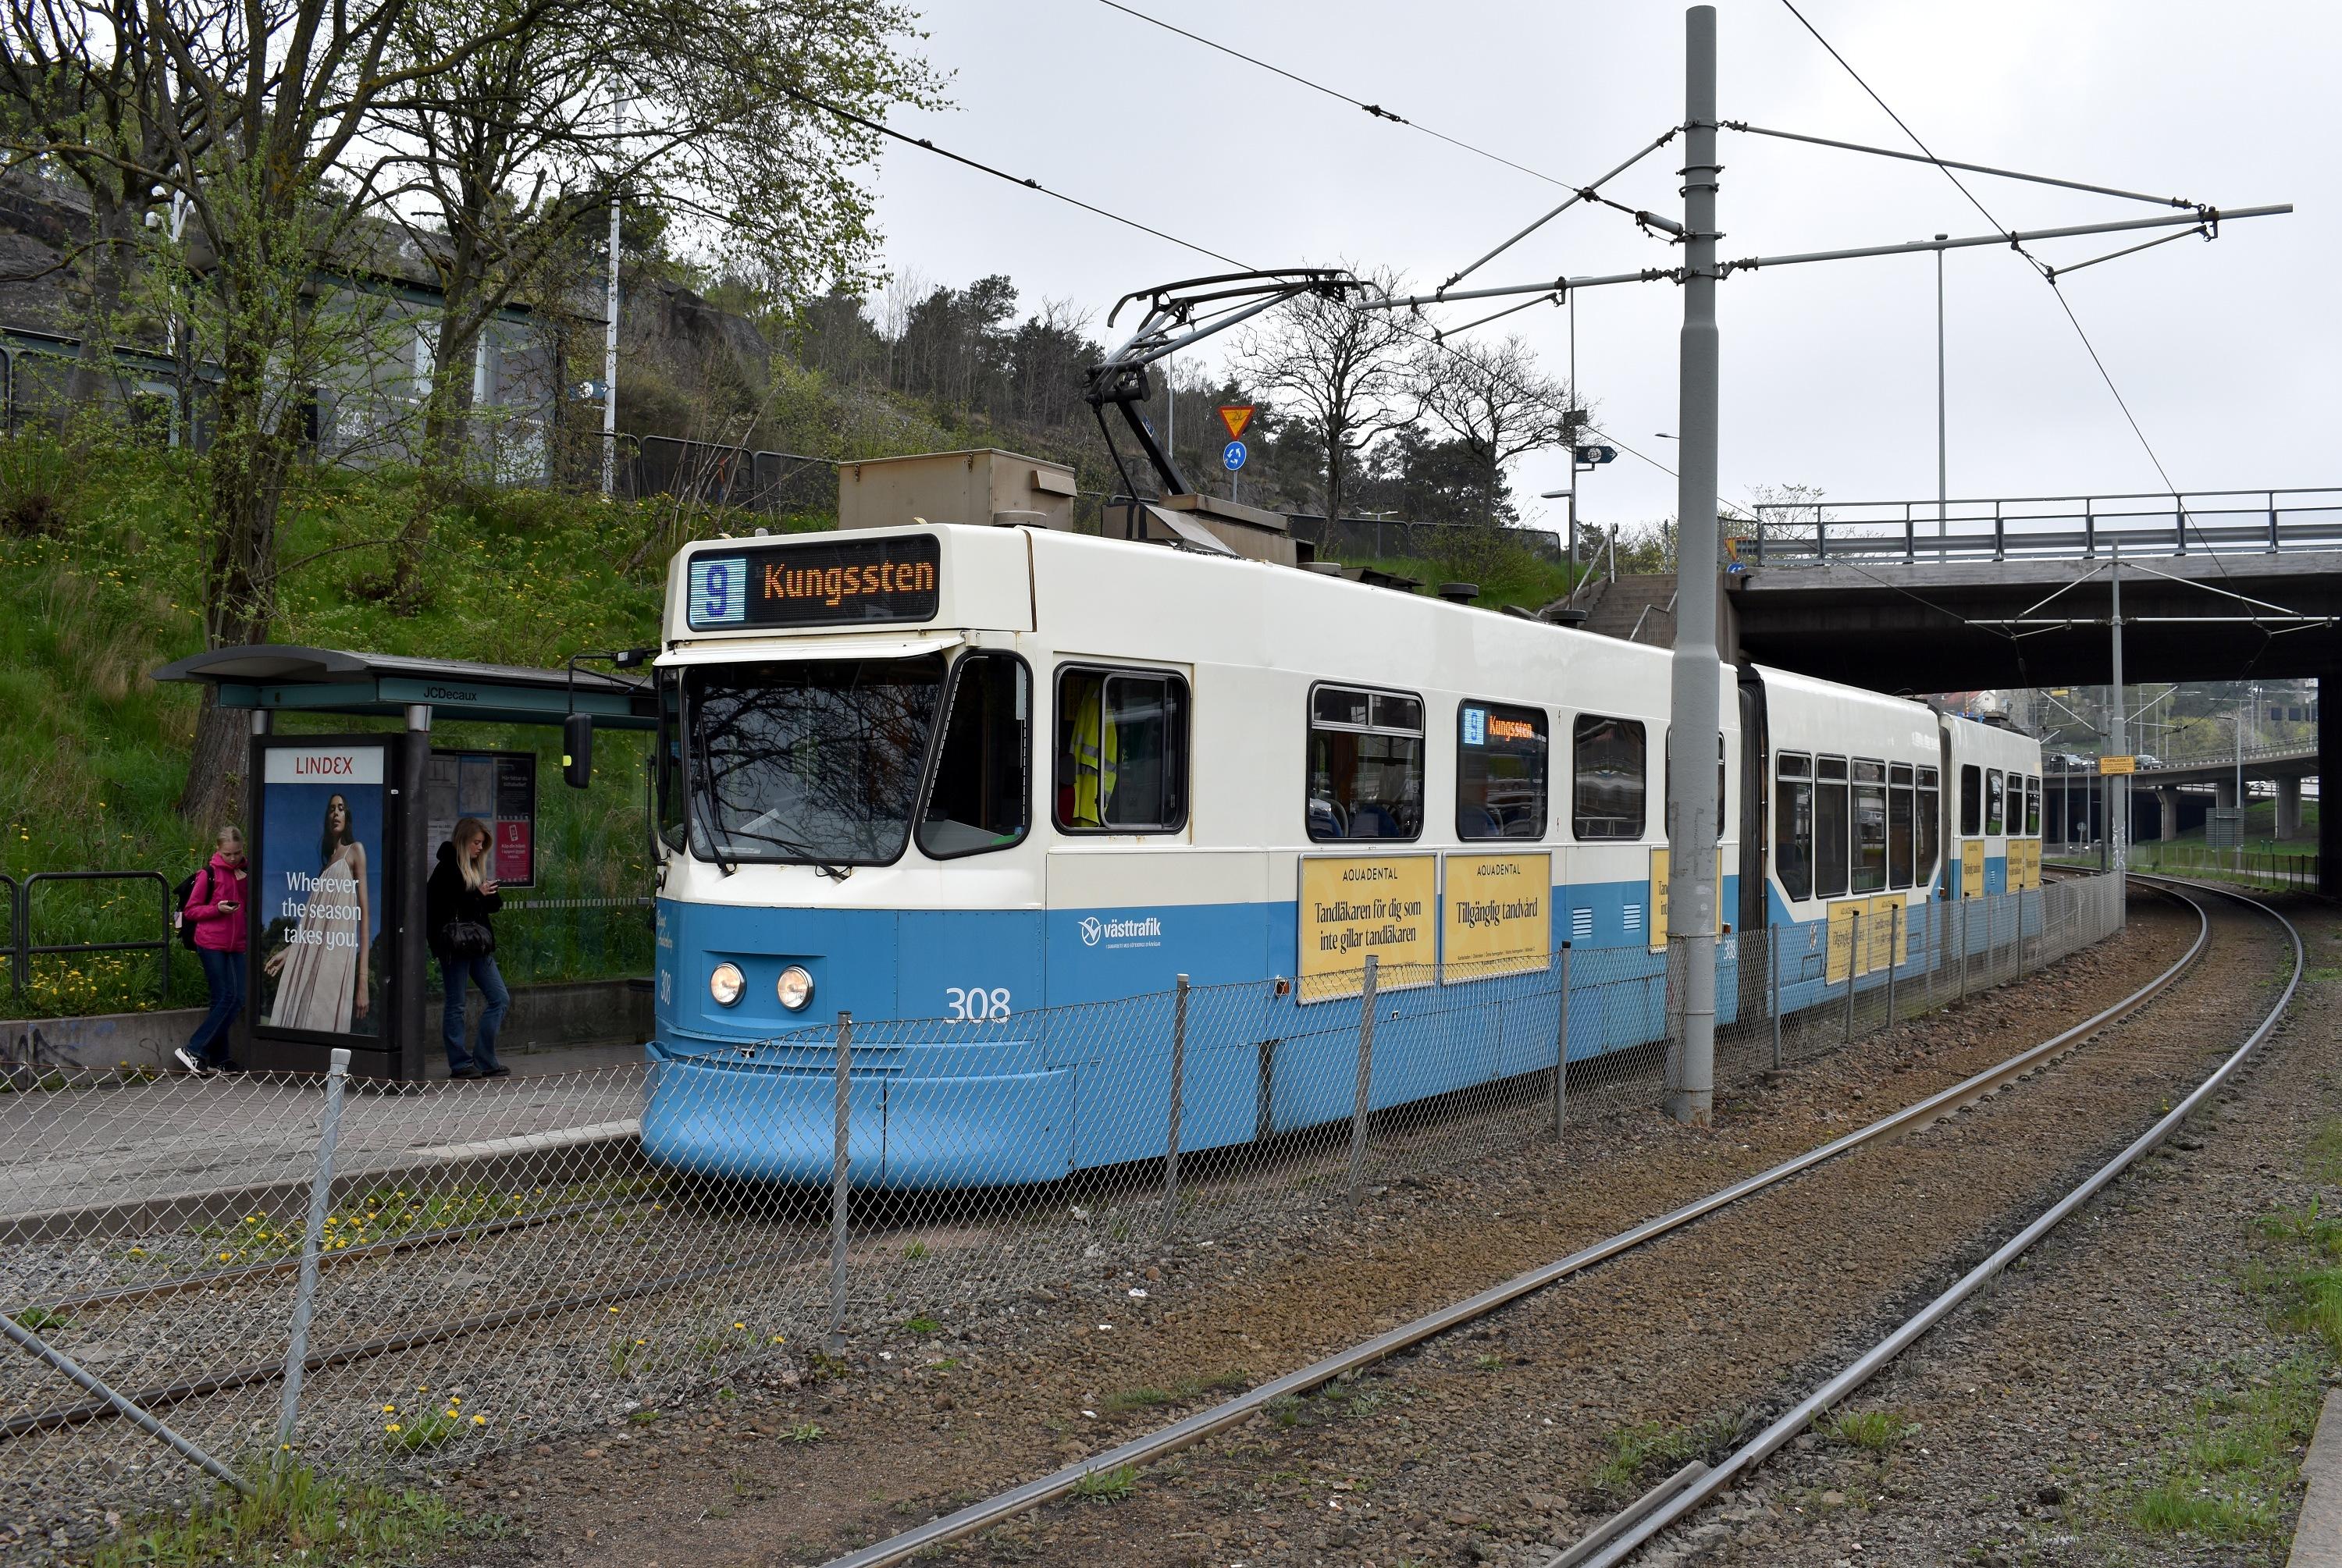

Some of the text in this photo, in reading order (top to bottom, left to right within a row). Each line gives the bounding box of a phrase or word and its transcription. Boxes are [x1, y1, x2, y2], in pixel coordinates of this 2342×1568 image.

[705, 560, 933, 617] 9 Kungssten
[424, 687, 477, 701] JCDecaux
[1490, 715, 1532, 741] Kungssten
[296, 756, 353, 774] LINDEX
[1342, 867, 1398, 882] AQUADENTAL
[1476, 863, 1521, 876] AQUADENTAL
[287, 872, 359, 894] Wherever
[282, 898, 361, 921] the season
[1315, 898, 1421, 923] Tandläkaren för dig som
[1456, 897, 1538, 929] Tillgänglig tandvård
[284, 926, 359, 951] takes you.
[1103, 917, 1161, 938] västtrafik
[1320, 924, 1416, 955] inte gillar tandläkaren
[660, 969, 671, 1005] 308
[945, 987, 1011, 1023] 308
